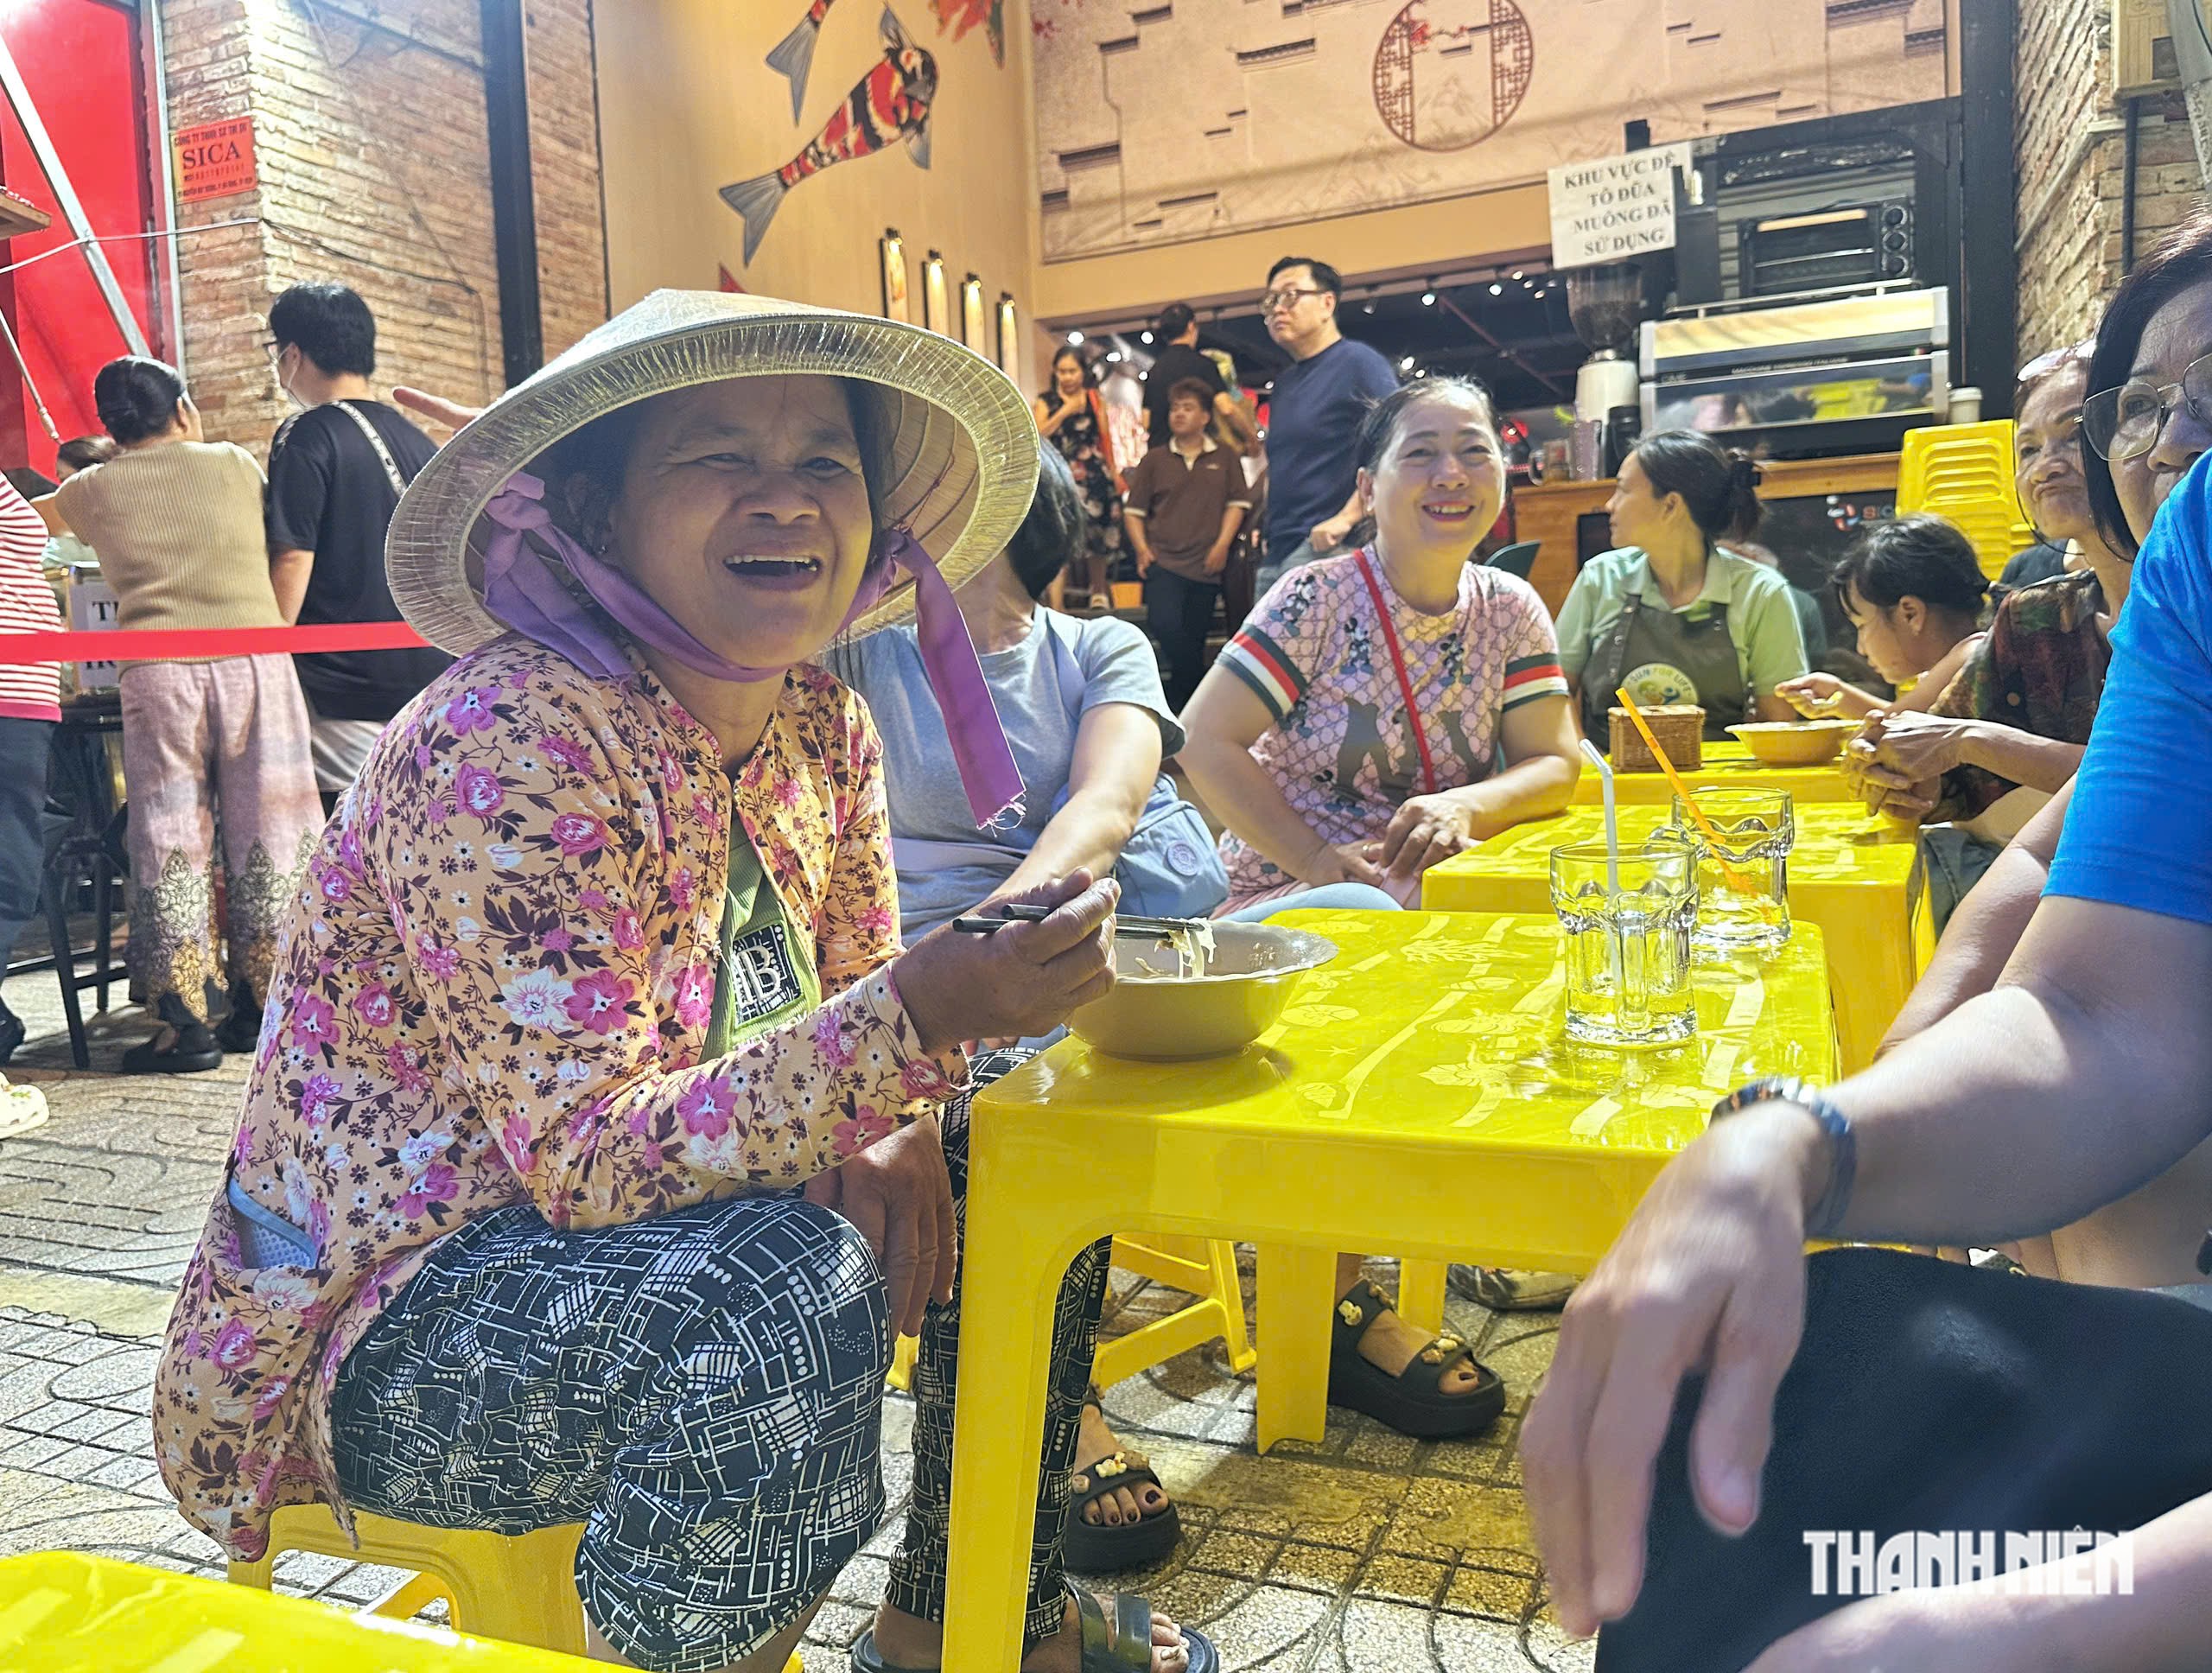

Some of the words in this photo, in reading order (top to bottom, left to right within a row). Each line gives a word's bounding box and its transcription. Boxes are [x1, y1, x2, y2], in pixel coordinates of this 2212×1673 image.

[182, 141, 241, 170] SICA
[1565, 168, 1605, 189] KHU
[1607, 159, 1647, 180] VỰC
[1613, 227, 1665, 251] DỤNG
